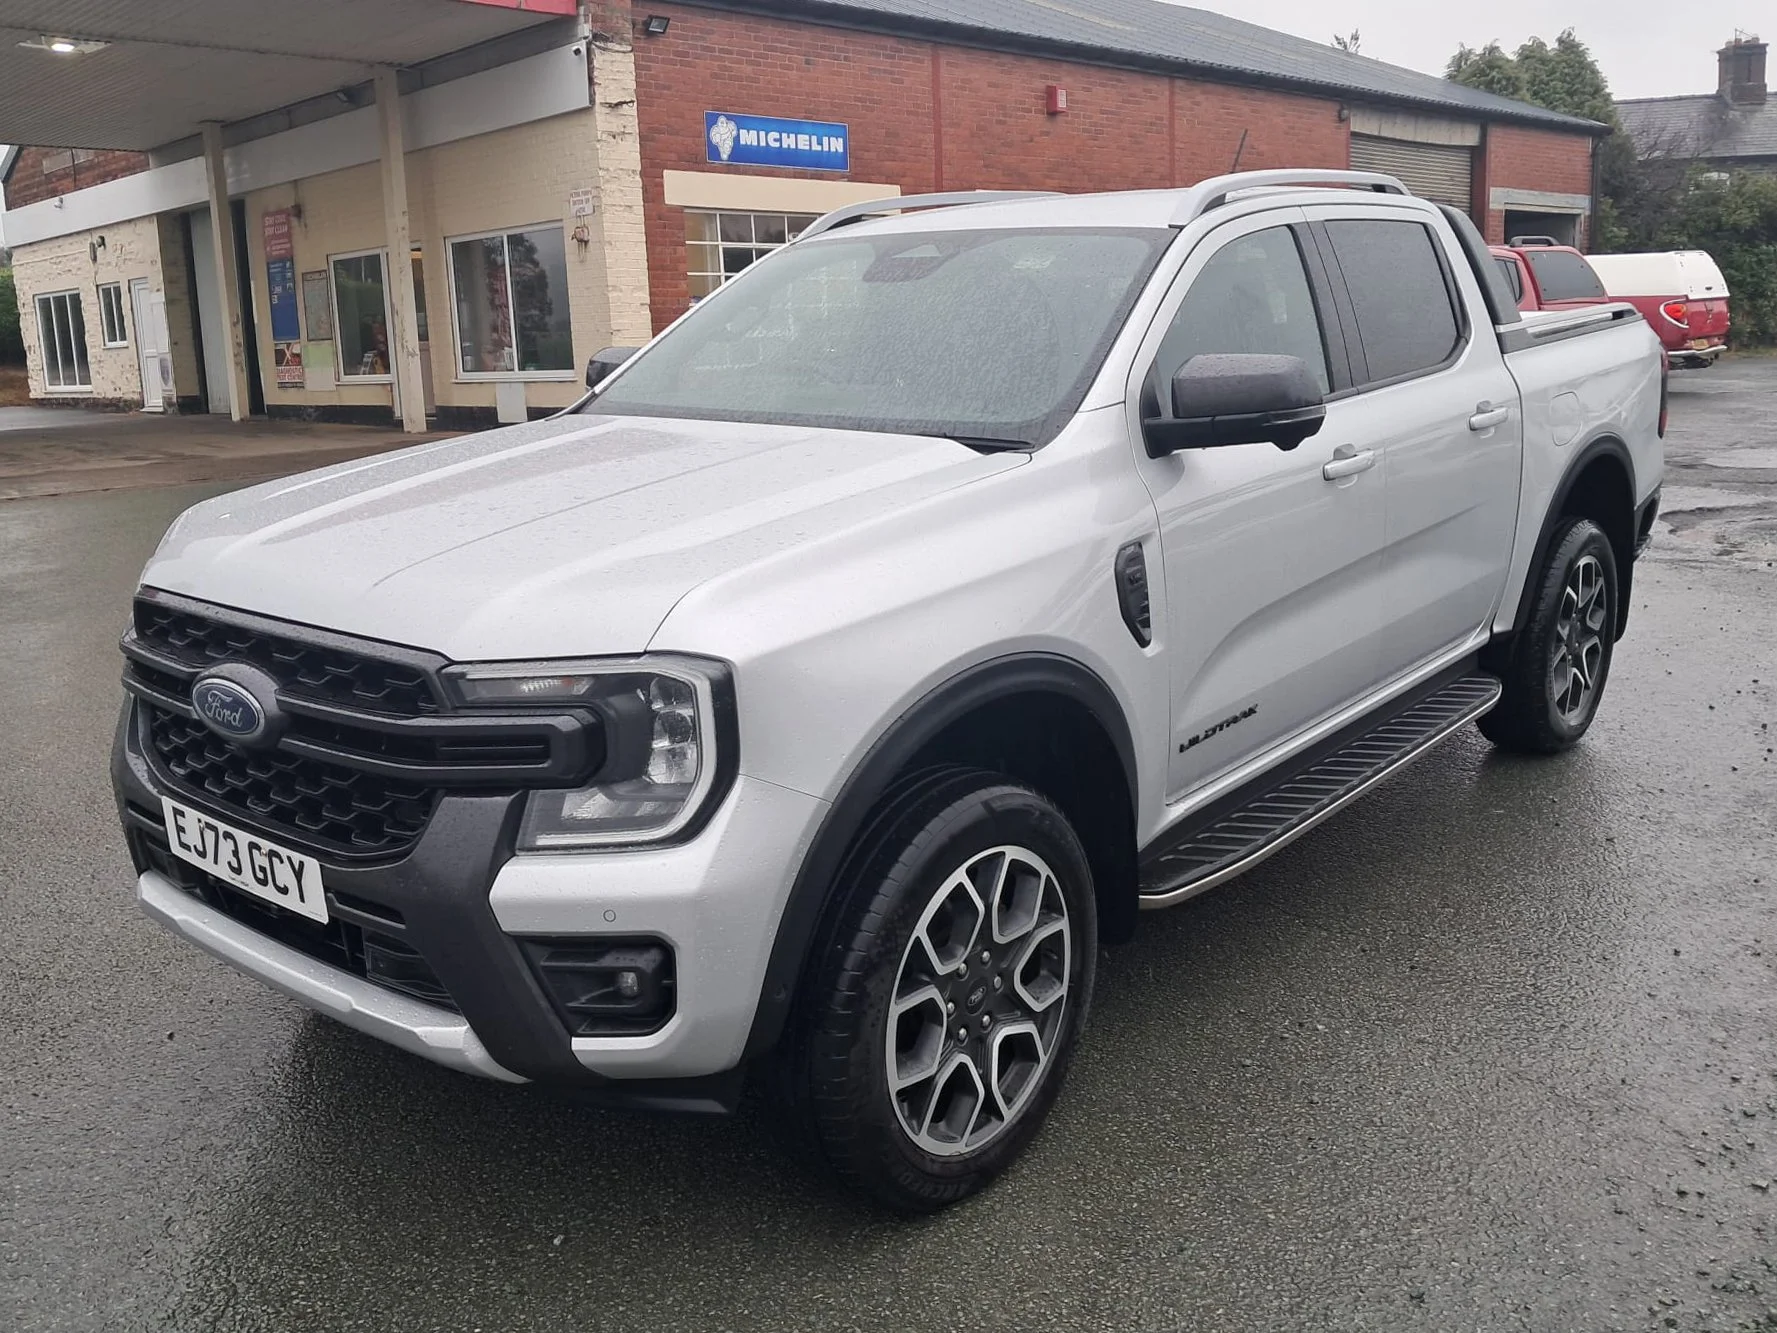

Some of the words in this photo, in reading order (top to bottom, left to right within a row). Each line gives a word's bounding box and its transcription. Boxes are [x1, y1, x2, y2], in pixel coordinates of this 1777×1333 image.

[739, 129, 844, 153] MICHELIN
[205, 690, 243, 727] Ford
[1179, 703, 1258, 753] WILDTRAK
[171, 806, 243, 876] EJ73
[248, 841, 306, 904] GCY
